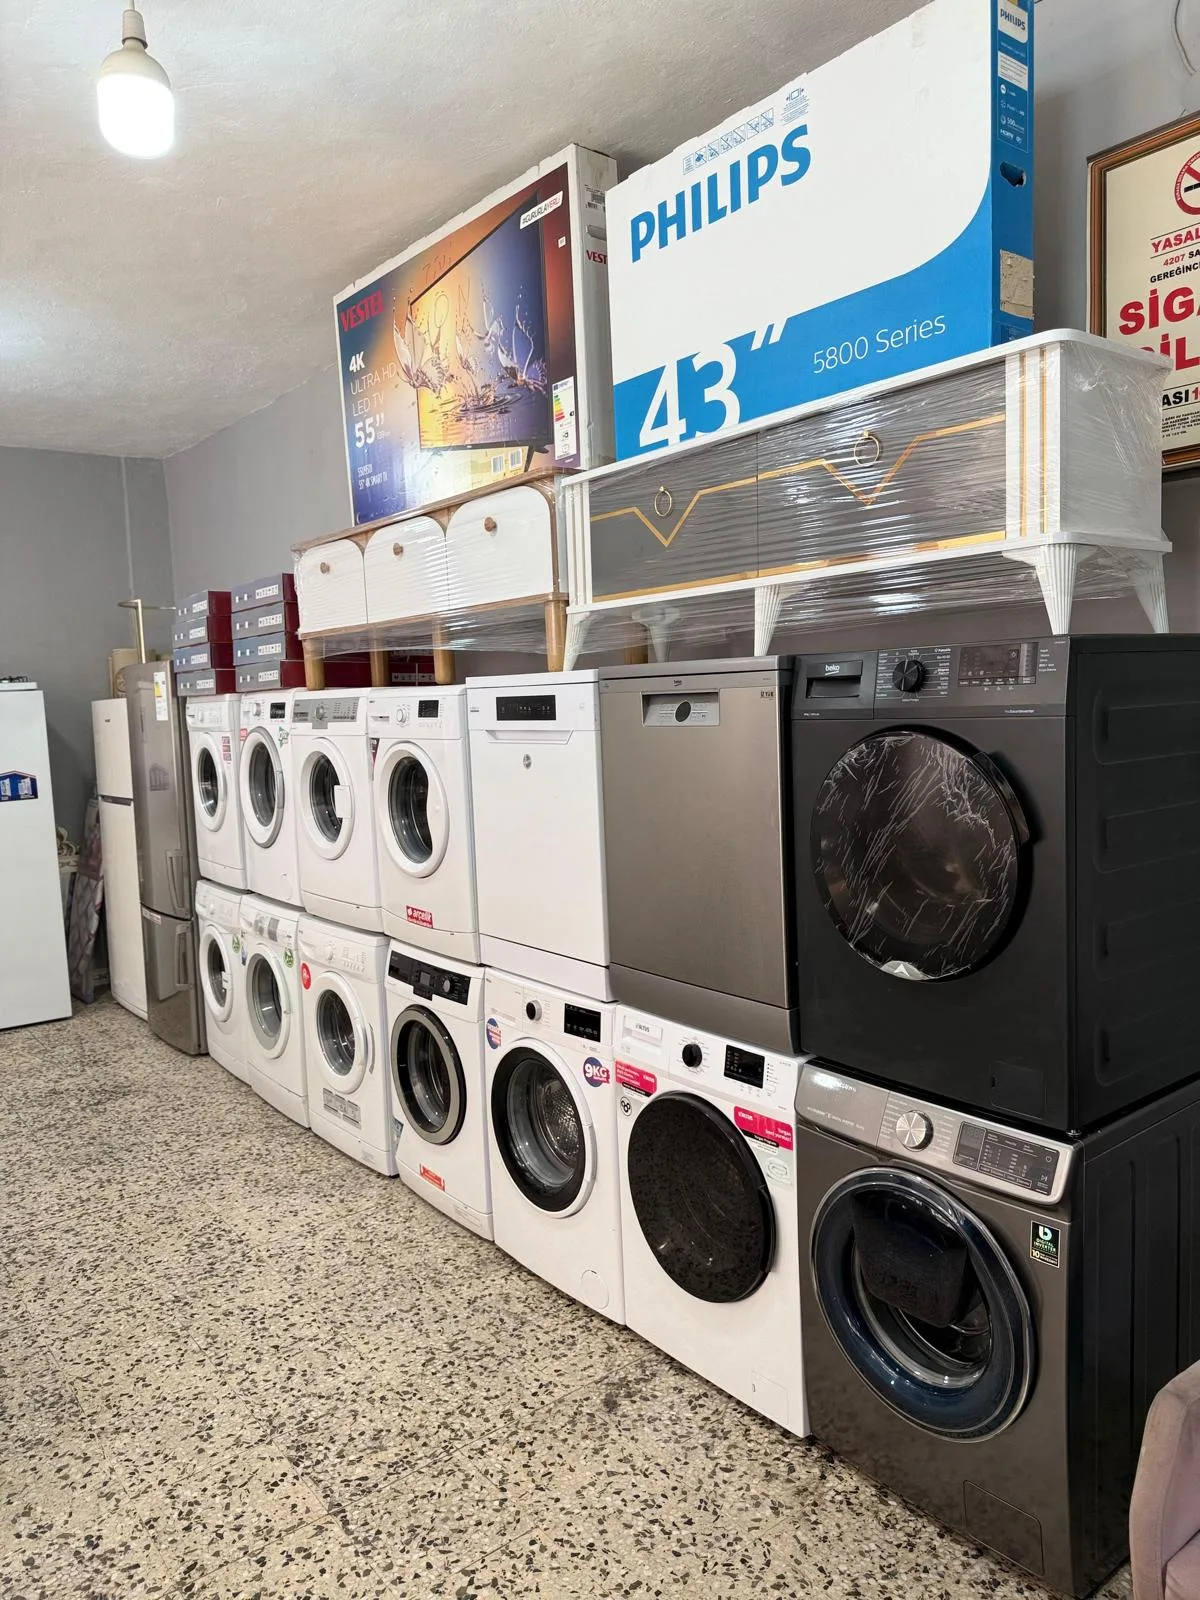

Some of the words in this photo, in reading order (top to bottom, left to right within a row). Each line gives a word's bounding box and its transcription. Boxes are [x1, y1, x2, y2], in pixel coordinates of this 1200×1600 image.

[1000, 8, 1026, 31] PHILIPS
[630, 124, 811, 263] PHILIPS
[1151, 227, 1200, 253] YASAL
[1163, 253, 1186, 267] 4207
[340, 289, 385, 333] VESTEL
[1119, 286, 1200, 336] SİG
[812, 336, 869, 374] 5800
[875, 315, 947, 354] Series
[1140, 333, 1200, 371] İL
[349, 351, 366, 373] 4K
[350, 370, 381, 395] ULTRA
[381, 361, 397, 380] HD
[352, 396, 371, 416] LED
[372, 391, 385, 408] TV
[825, 664, 840, 672] beko
[584, 1063, 607, 1079] 9KG
